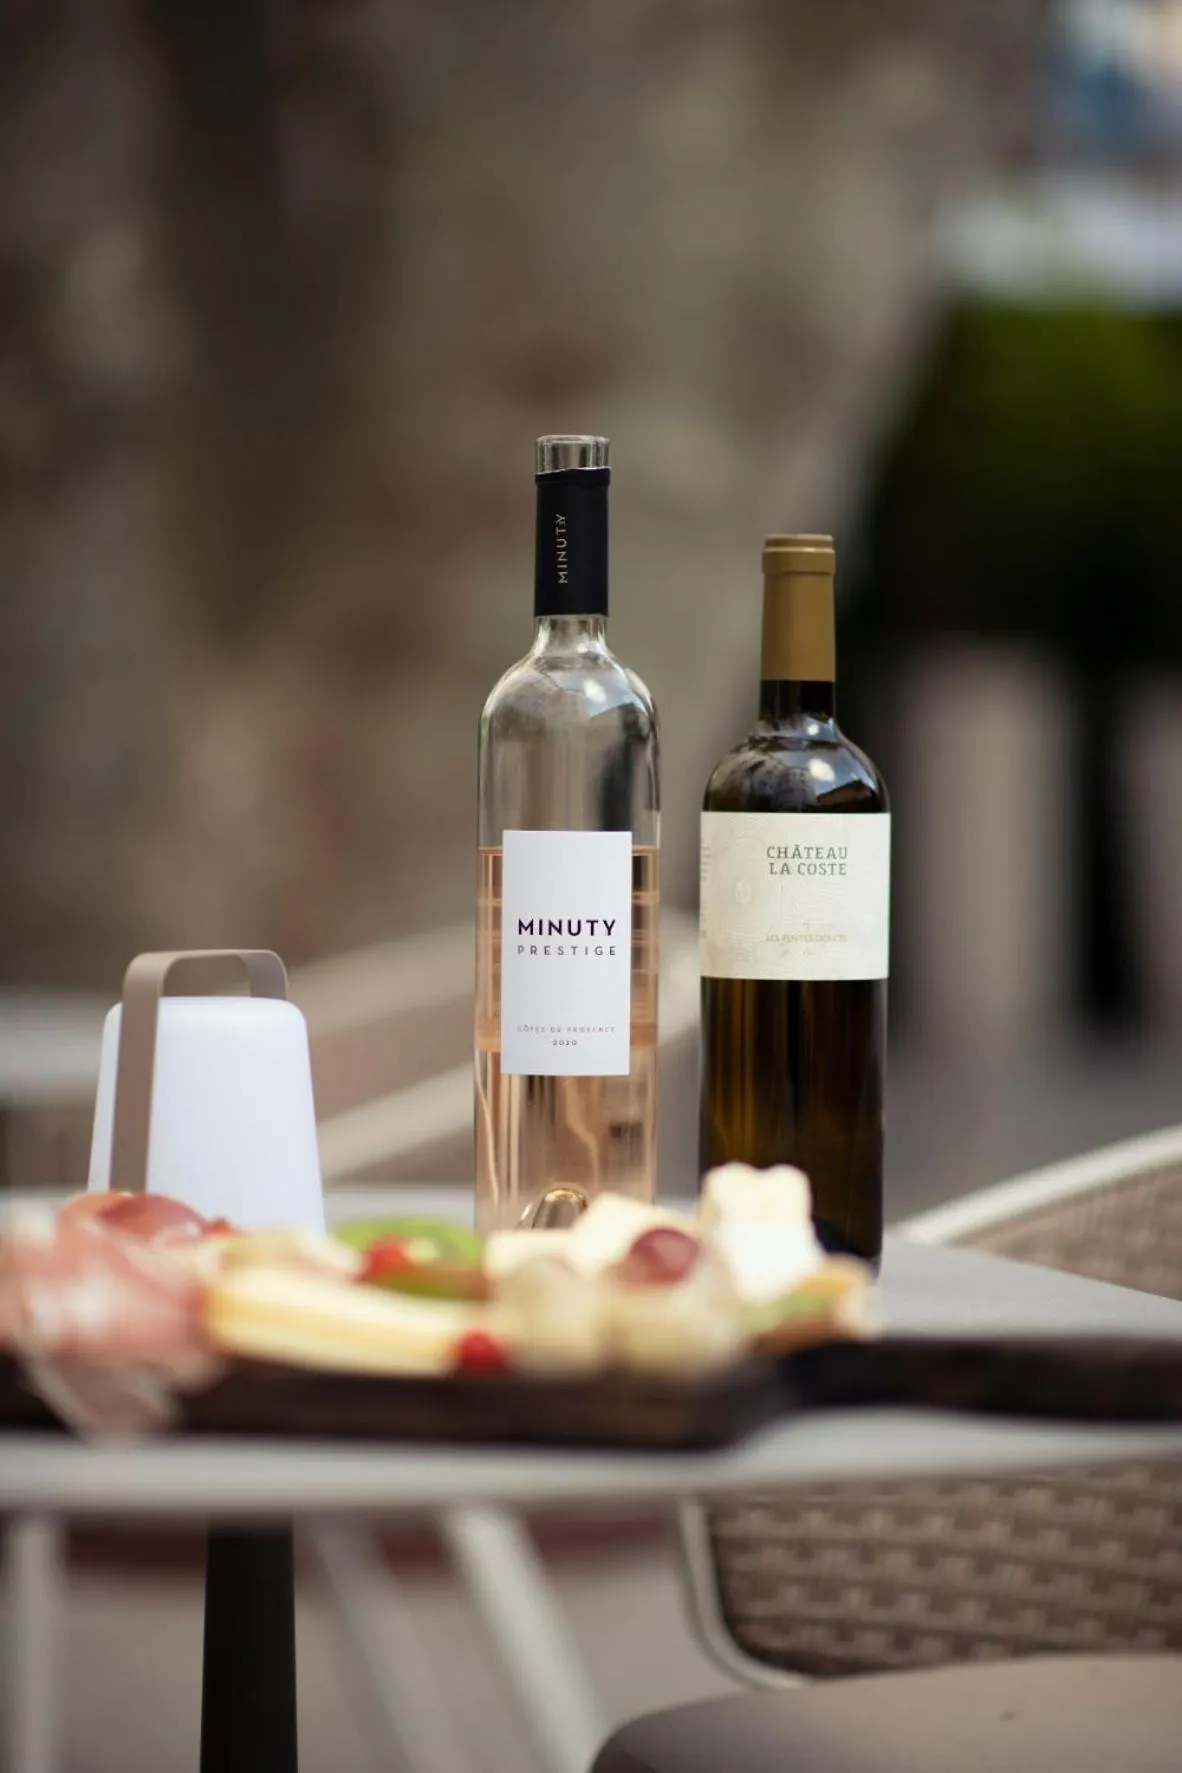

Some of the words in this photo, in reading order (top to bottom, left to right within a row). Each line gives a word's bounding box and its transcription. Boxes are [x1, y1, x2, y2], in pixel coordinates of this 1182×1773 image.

[555, 513, 568, 584] MINUTY
[766, 845, 848, 860] CHÂTEAU
[769, 862, 791, 876] LA
[797, 862, 847, 876] COSTE
[518, 919, 616, 936] MINUTY
[517, 945, 616, 956] PRESTIGE
